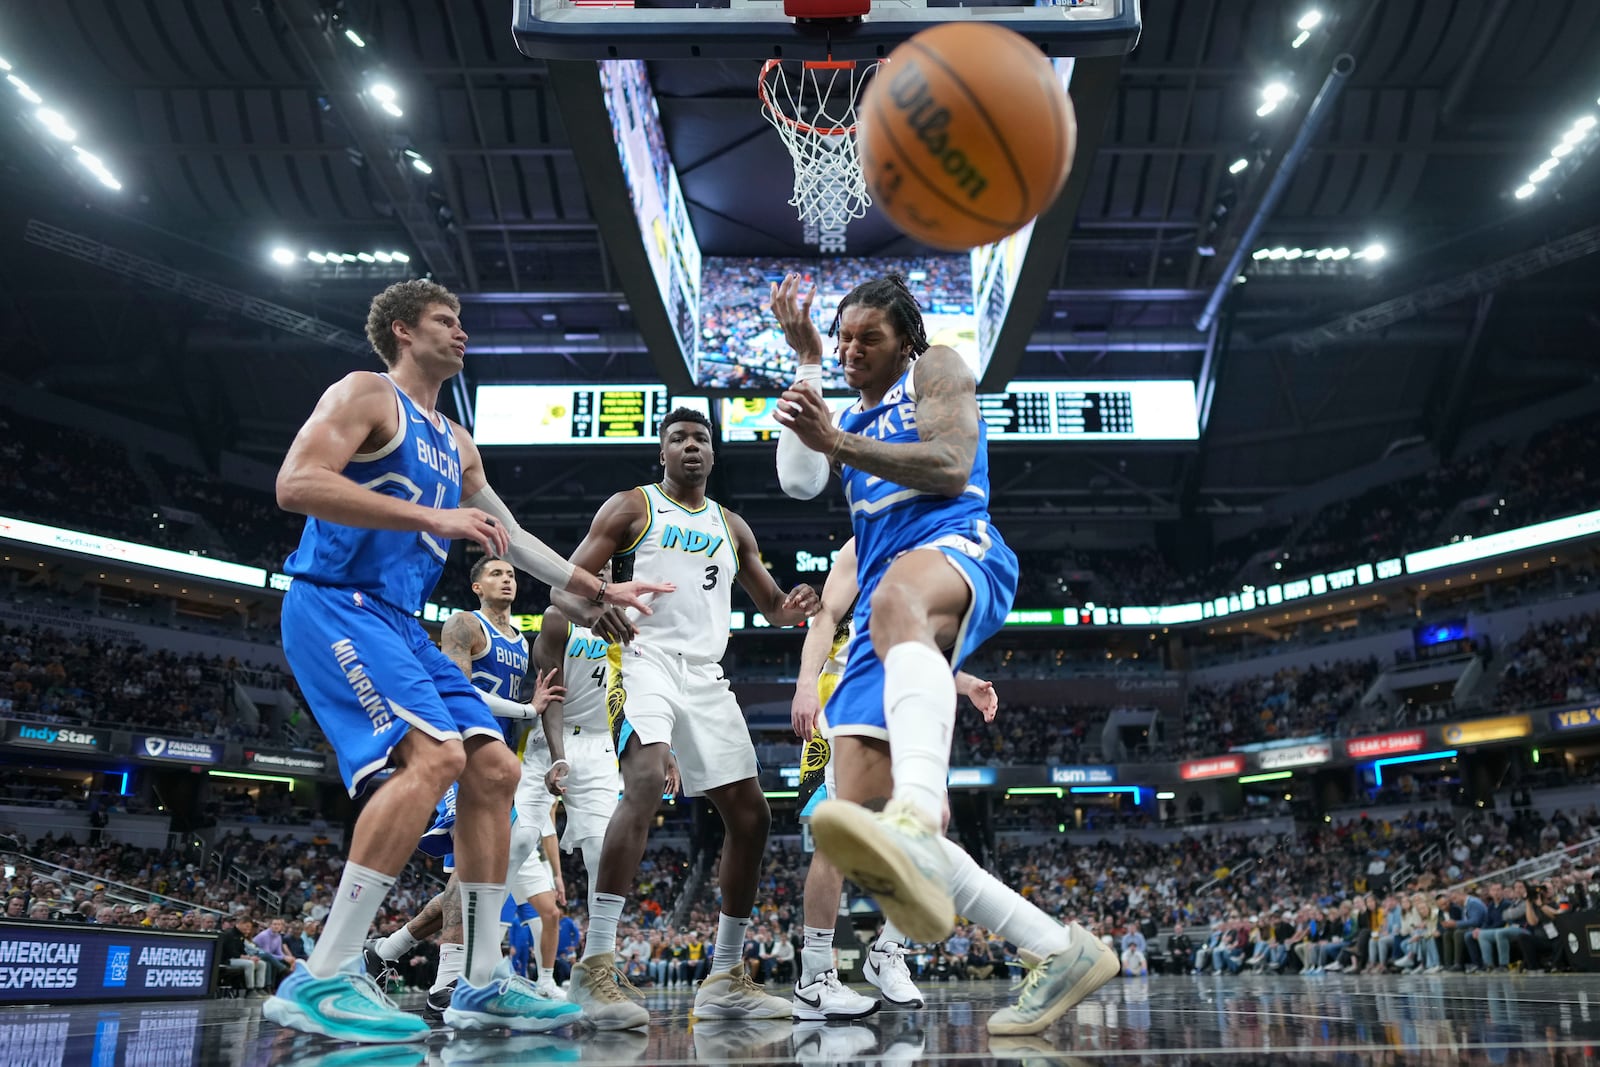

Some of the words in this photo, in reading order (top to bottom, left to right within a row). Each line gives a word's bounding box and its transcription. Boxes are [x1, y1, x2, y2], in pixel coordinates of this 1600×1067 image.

[888, 60, 989, 201] Wilson
[416, 436, 461, 487] BUCKS
[660, 523, 725, 560] INDY
[795, 550, 829, 573] Sire
[702, 564, 720, 591] 3
[568, 637, 610, 660] IND
[330, 638, 393, 737] MILWAUKEE
[509, 672, 522, 700] 18
[591, 665, 607, 689] 4
[168, 741, 213, 753] FANDUEL
[1348, 739, 1381, 753] STEAK
[1388, 733, 1422, 749] SHAKE
[1052, 767, 1086, 782] ksm
[0, 940, 81, 964] MERICAN
[112, 952, 130, 968] AM
[137, 946, 207, 968] AMERICAN
[0, 967, 79, 988] EXPRESS
[111, 966, 127, 981] EX
[145, 968, 205, 988] EXPRESS
